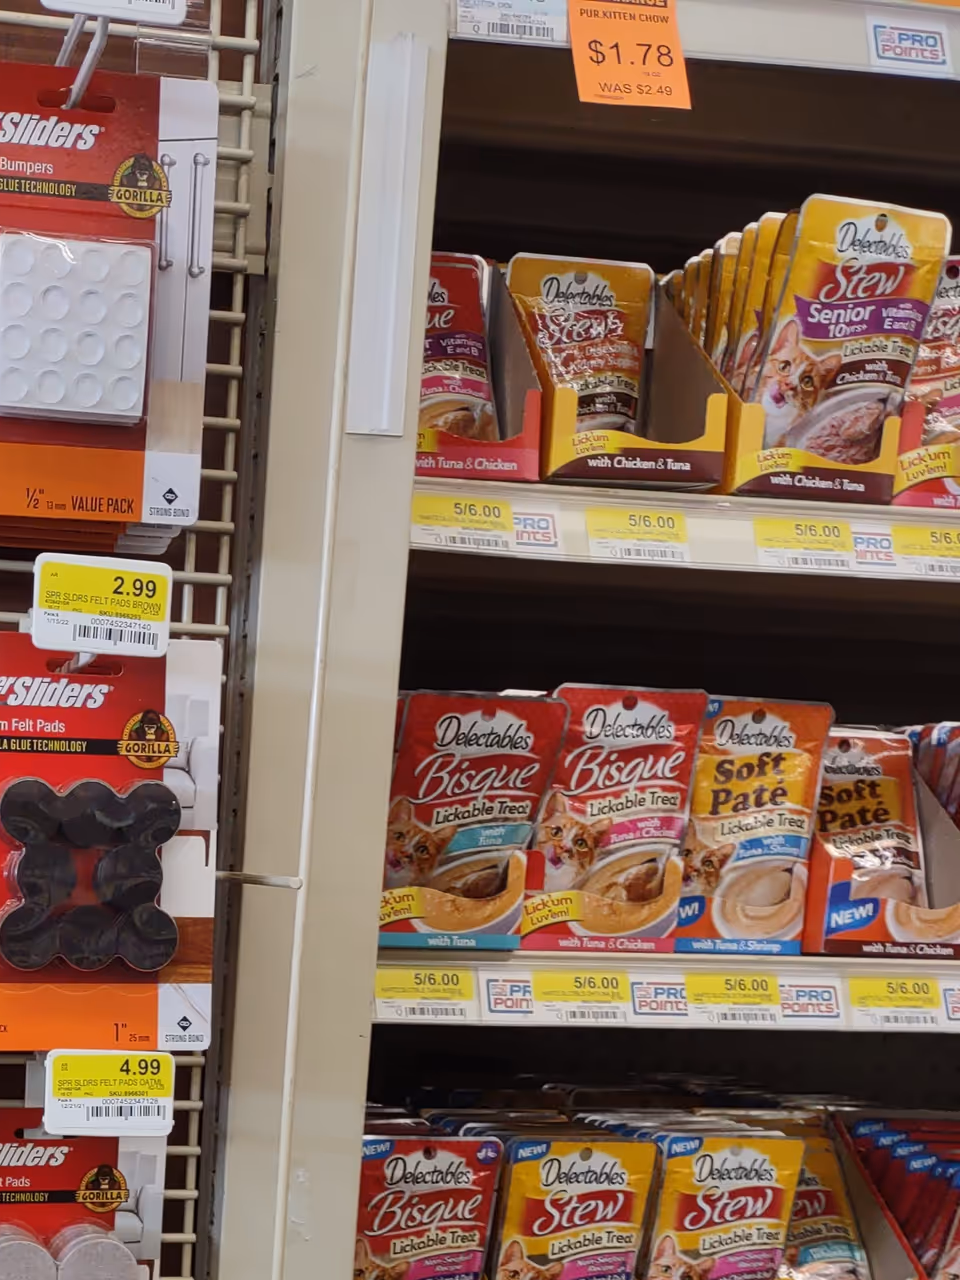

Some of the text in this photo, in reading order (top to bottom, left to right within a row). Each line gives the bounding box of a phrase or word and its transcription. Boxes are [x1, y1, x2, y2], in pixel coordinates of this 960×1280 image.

[588, 39, 673, 66] $1.78
[599, 82, 672, 95] WAS $2.49
[0, 157, 53, 174] Bumpers
[21, 180, 76, 196] TECHNOLOGY
[116, 189, 163, 204] GORILLA
[819, 258, 904, 303] Stew
[542, 276, 616, 308] Delectables
[807, 304, 875, 324] Senior
[438, 458, 518, 470] Tuna & Chicken
[588, 458, 690, 470] with Chicken & Tuna
[771, 476, 792, 486] with
[794, 476, 832, 488] Chicken
[842, 478, 864, 491] Tuna
[72, 496, 134, 515] VALUE PACK
[453, 502, 501, 519] 5/6.00
[628, 514, 675, 529] 5/6.00
[795, 523, 841, 537] 5/6.00
[113, 576, 156, 598] 2.99
[11, 739, 31, 751] GLUE
[33, 739, 87, 752] TECHNOLOGY
[125, 743, 171, 754] GORILLA
[713, 752, 786, 785] Soft
[428, 936, 477, 947] with Tuna
[558, 937, 655, 949] with Tuna & Chicken
[796, 990, 832, 1001] PRO
[120, 1059, 160, 1075] 4.99
[671, 1140, 700, 1154] NEW!
[6, 1176, 30, 1187] Pads
[82, 1192, 123, 1201] GORILLA
[364, 1189, 483, 1236] Bisque
[533, 1191, 624, 1236] Stew
[684, 1186, 773, 1229] Stew
